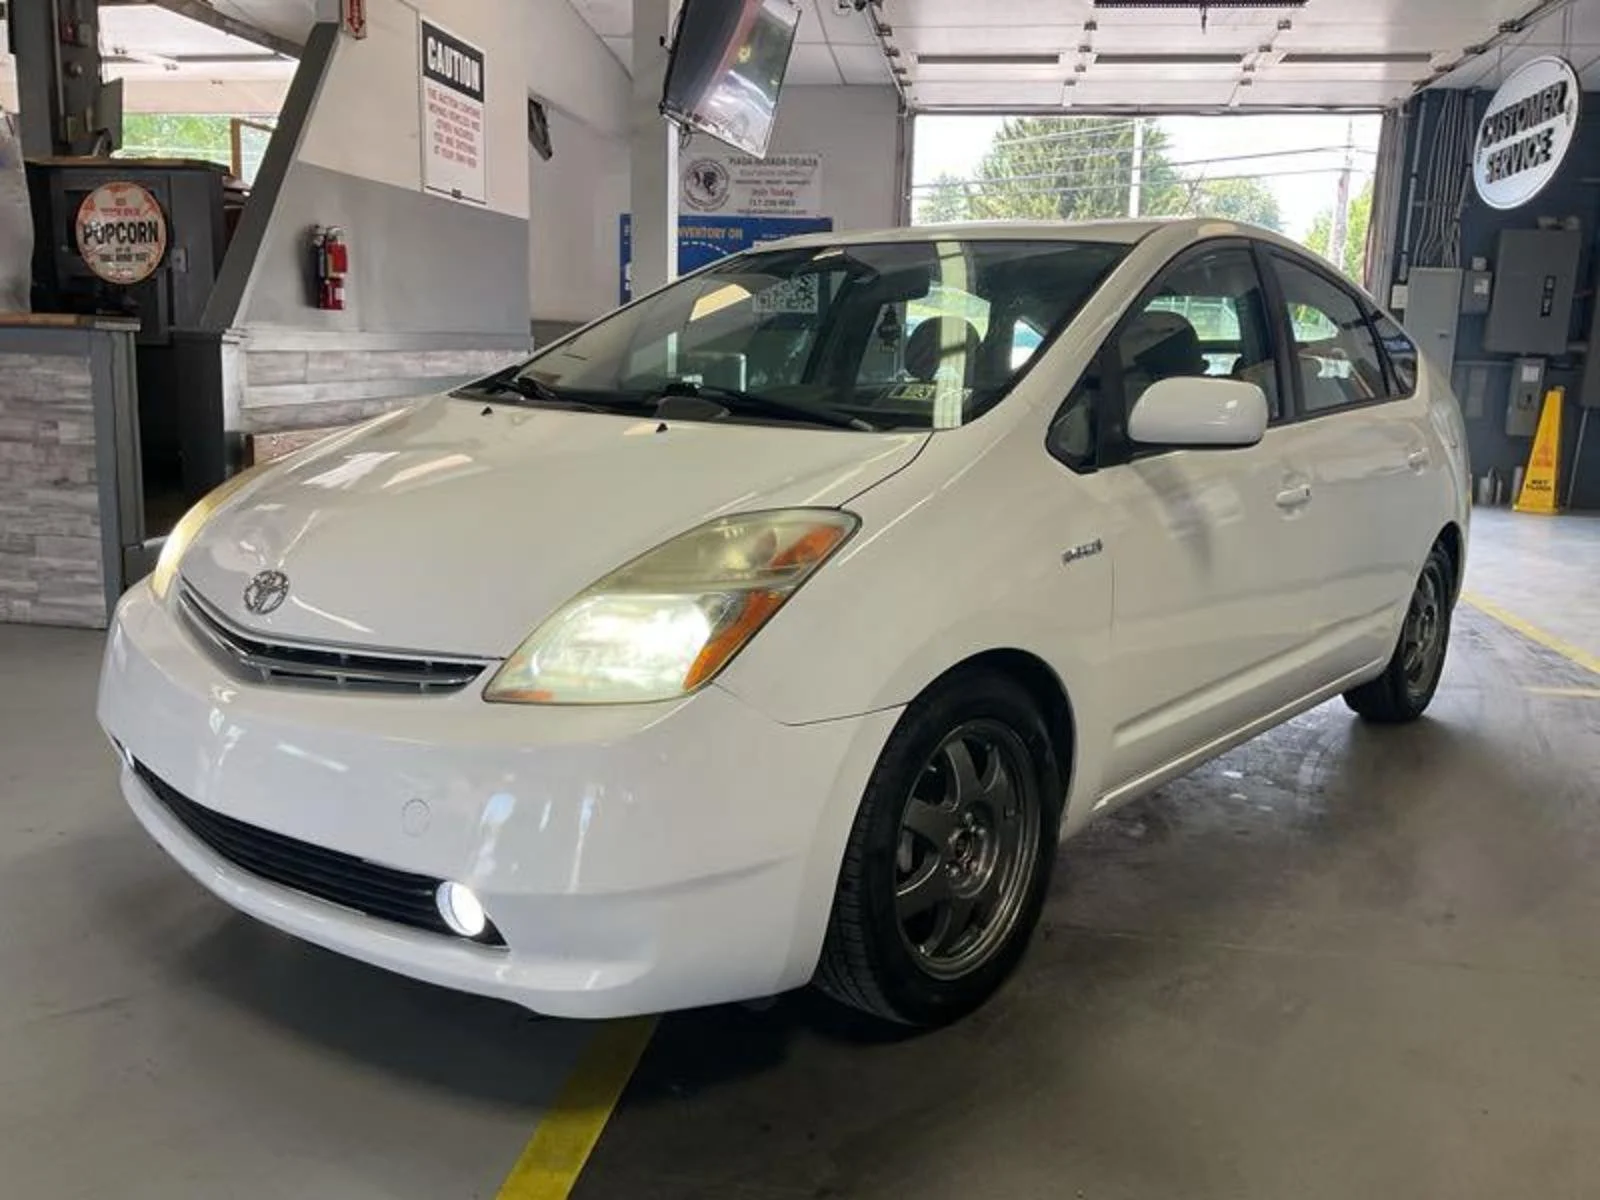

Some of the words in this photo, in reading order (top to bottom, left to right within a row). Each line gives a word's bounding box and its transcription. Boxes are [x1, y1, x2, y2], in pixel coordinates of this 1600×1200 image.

[427, 36, 480, 92] CAUTION
[1481, 80, 1569, 148] CUSTOMER
[1485, 127, 1554, 185] SERVICE
[83, 220, 159, 244] POPCORN
